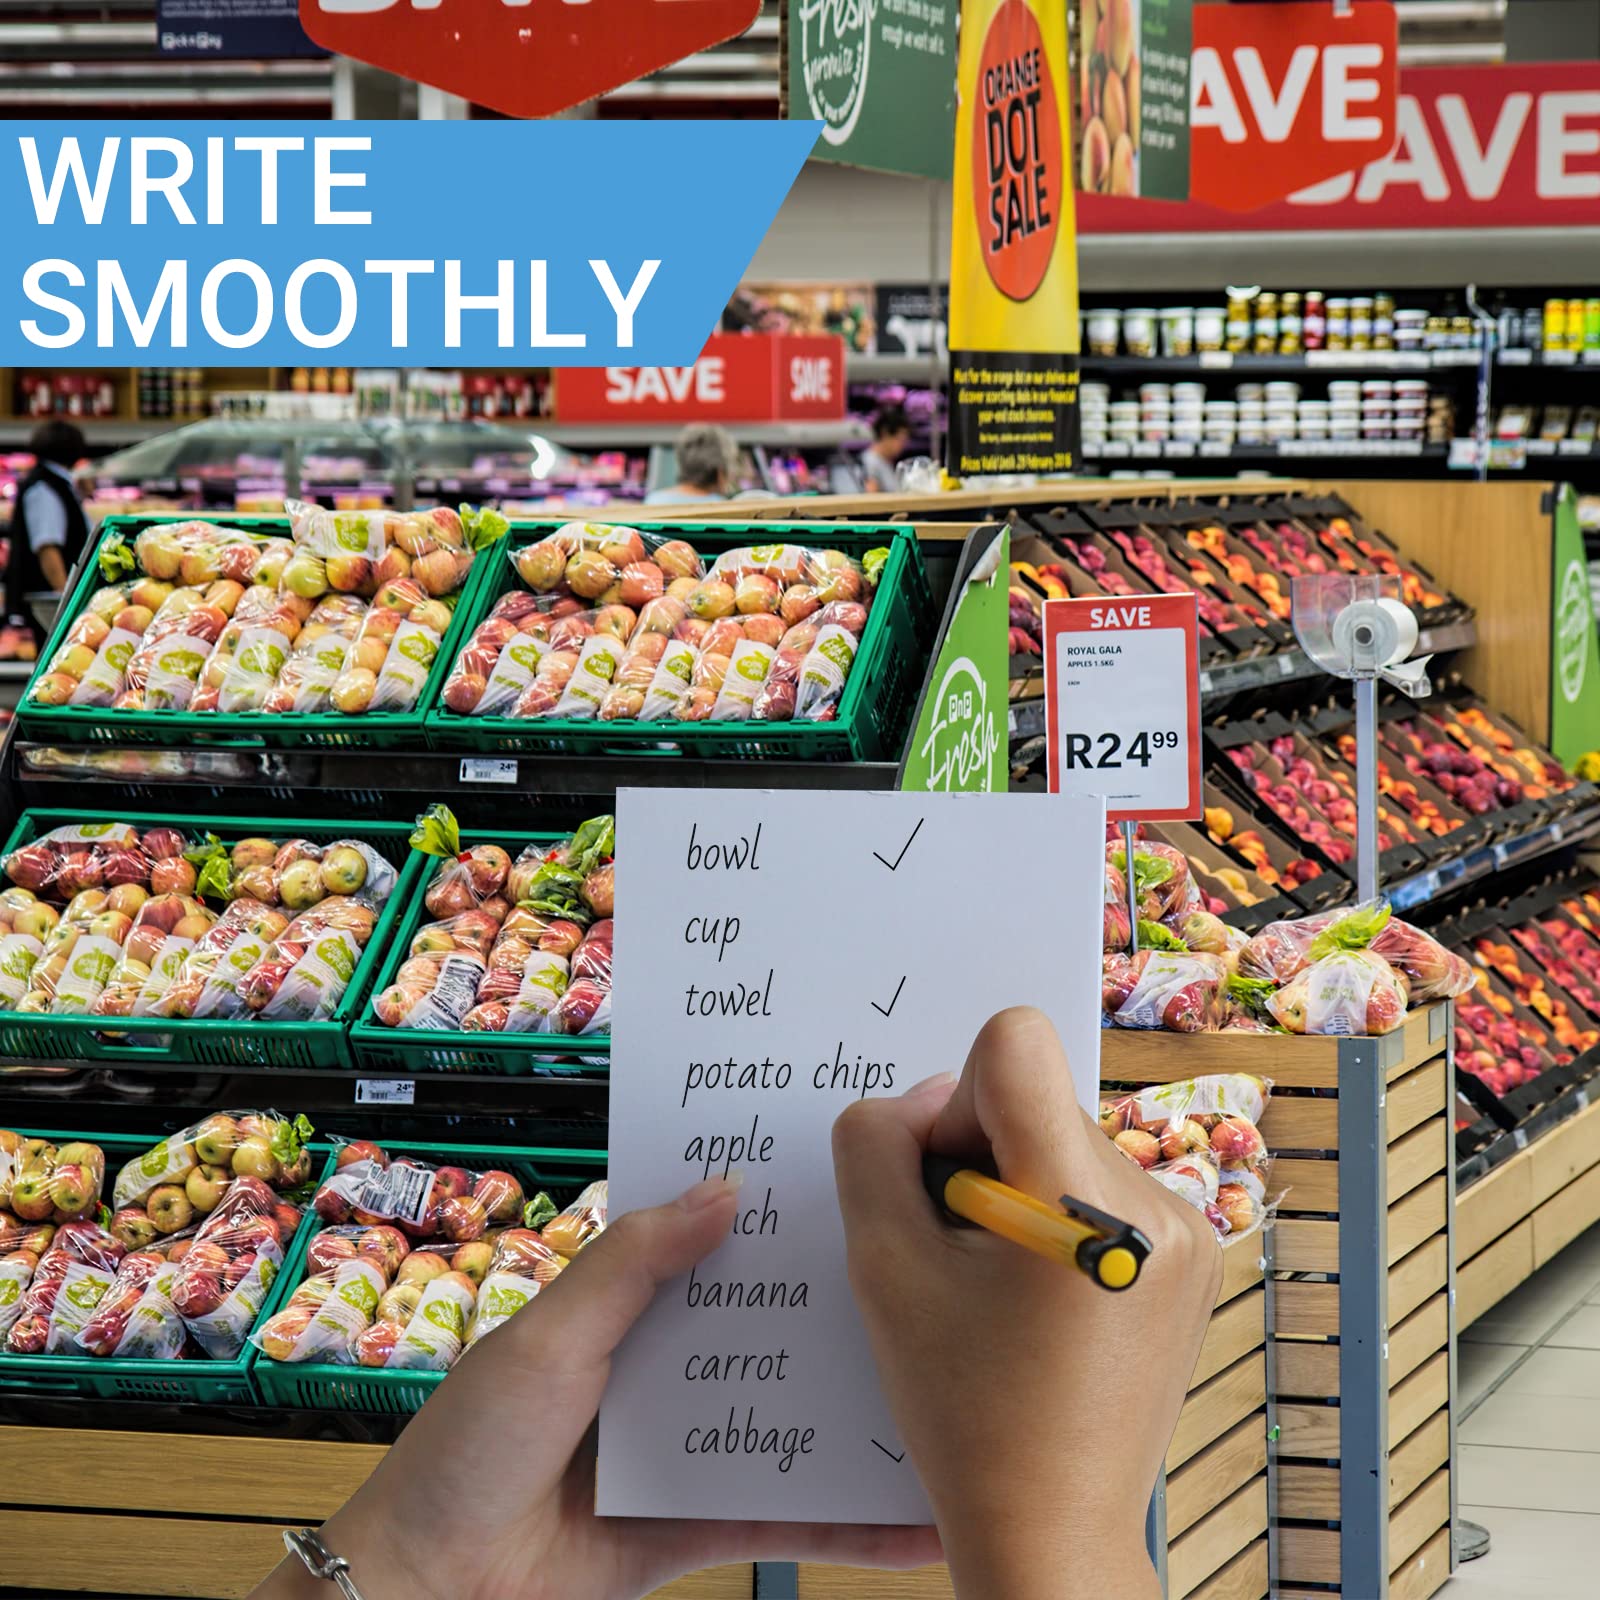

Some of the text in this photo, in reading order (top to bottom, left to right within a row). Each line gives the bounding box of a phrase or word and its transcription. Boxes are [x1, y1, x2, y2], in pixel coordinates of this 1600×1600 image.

[984, 48, 1041, 108] ORANGE
[1189, 44, 1384, 143] AVE
[986, 90, 1042, 187] DOT
[1285, 90, 1600, 204] AVE
[989, 165, 1051, 254] SALE
[605, 357, 725, 403] SAVE
[790, 356, 831, 403] SAVE
[1090, 606, 1151, 628] SAVE
[1067, 645, 1122, 655] ROYAL GALA
[949, 690, 972, 723] PnP
[921, 680, 999, 792] Fresh
[686, 822, 762, 871] bowl
[685, 916, 741, 963] cup
[686, 968, 774, 1017] towel
[682, 1041, 896, 1108] potato chips
[685, 1114, 774, 1181] apple
[687, 1266, 809, 1308] banana
[685, 1348, 790, 1382] carrot
[685, 1406, 815, 1473] cabbage
